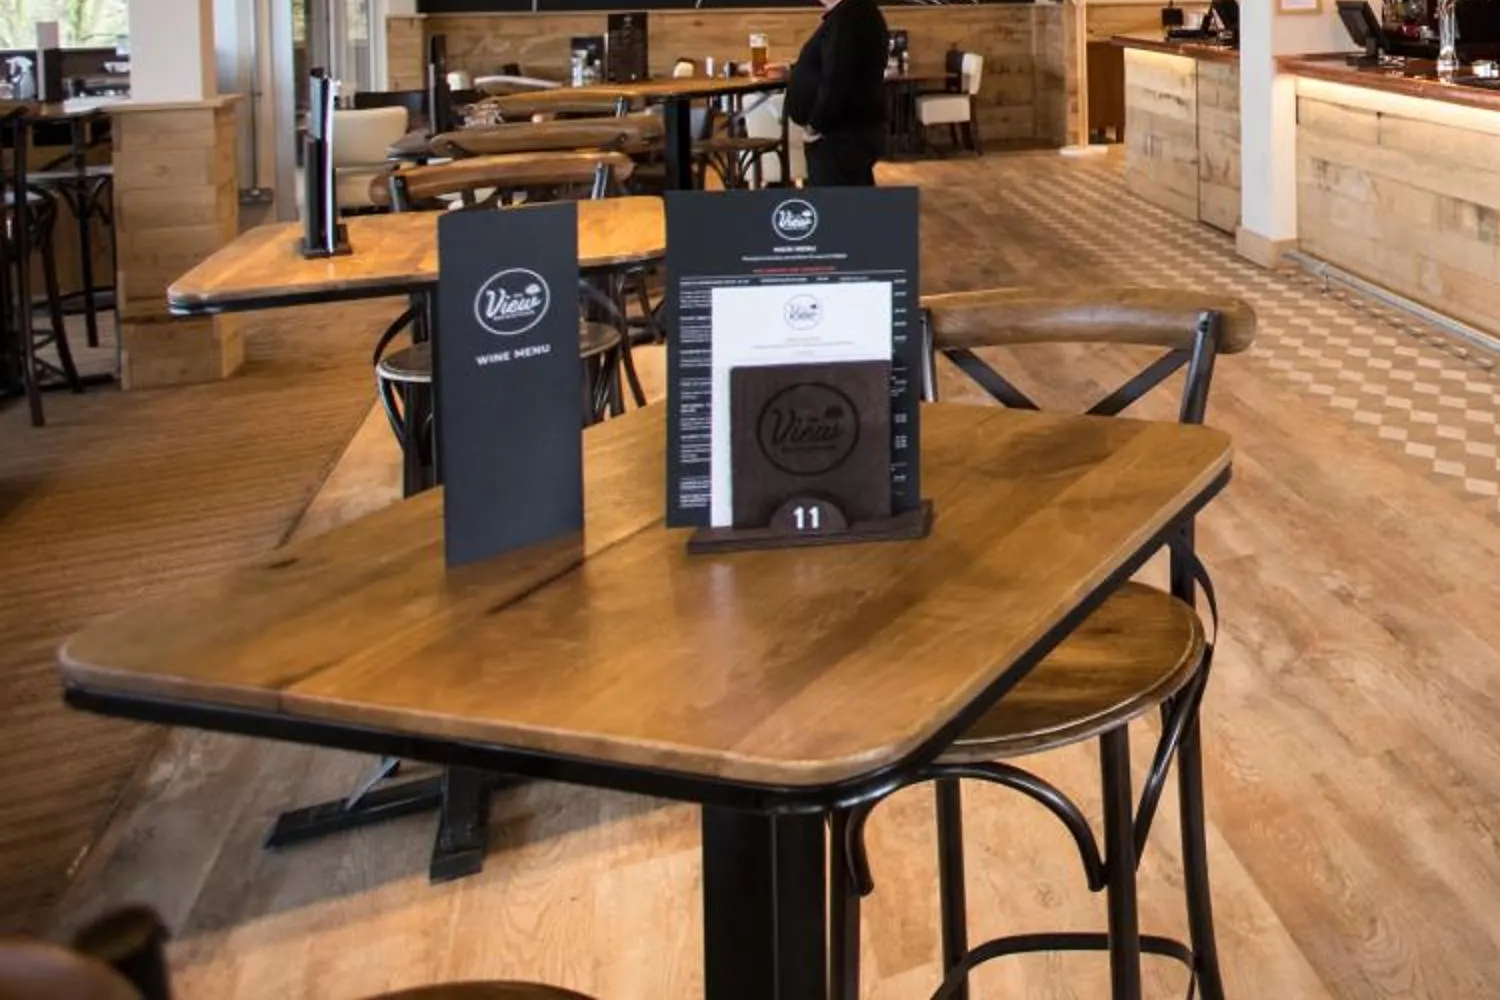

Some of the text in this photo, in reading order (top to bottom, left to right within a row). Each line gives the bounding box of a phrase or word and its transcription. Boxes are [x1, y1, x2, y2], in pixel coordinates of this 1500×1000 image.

[779, 210, 812, 228] View
[486, 287, 541, 318] View
[475, 342, 552, 366] WINE MENU
[772, 407, 841, 445] View
[793, 505, 820, 529] 11
